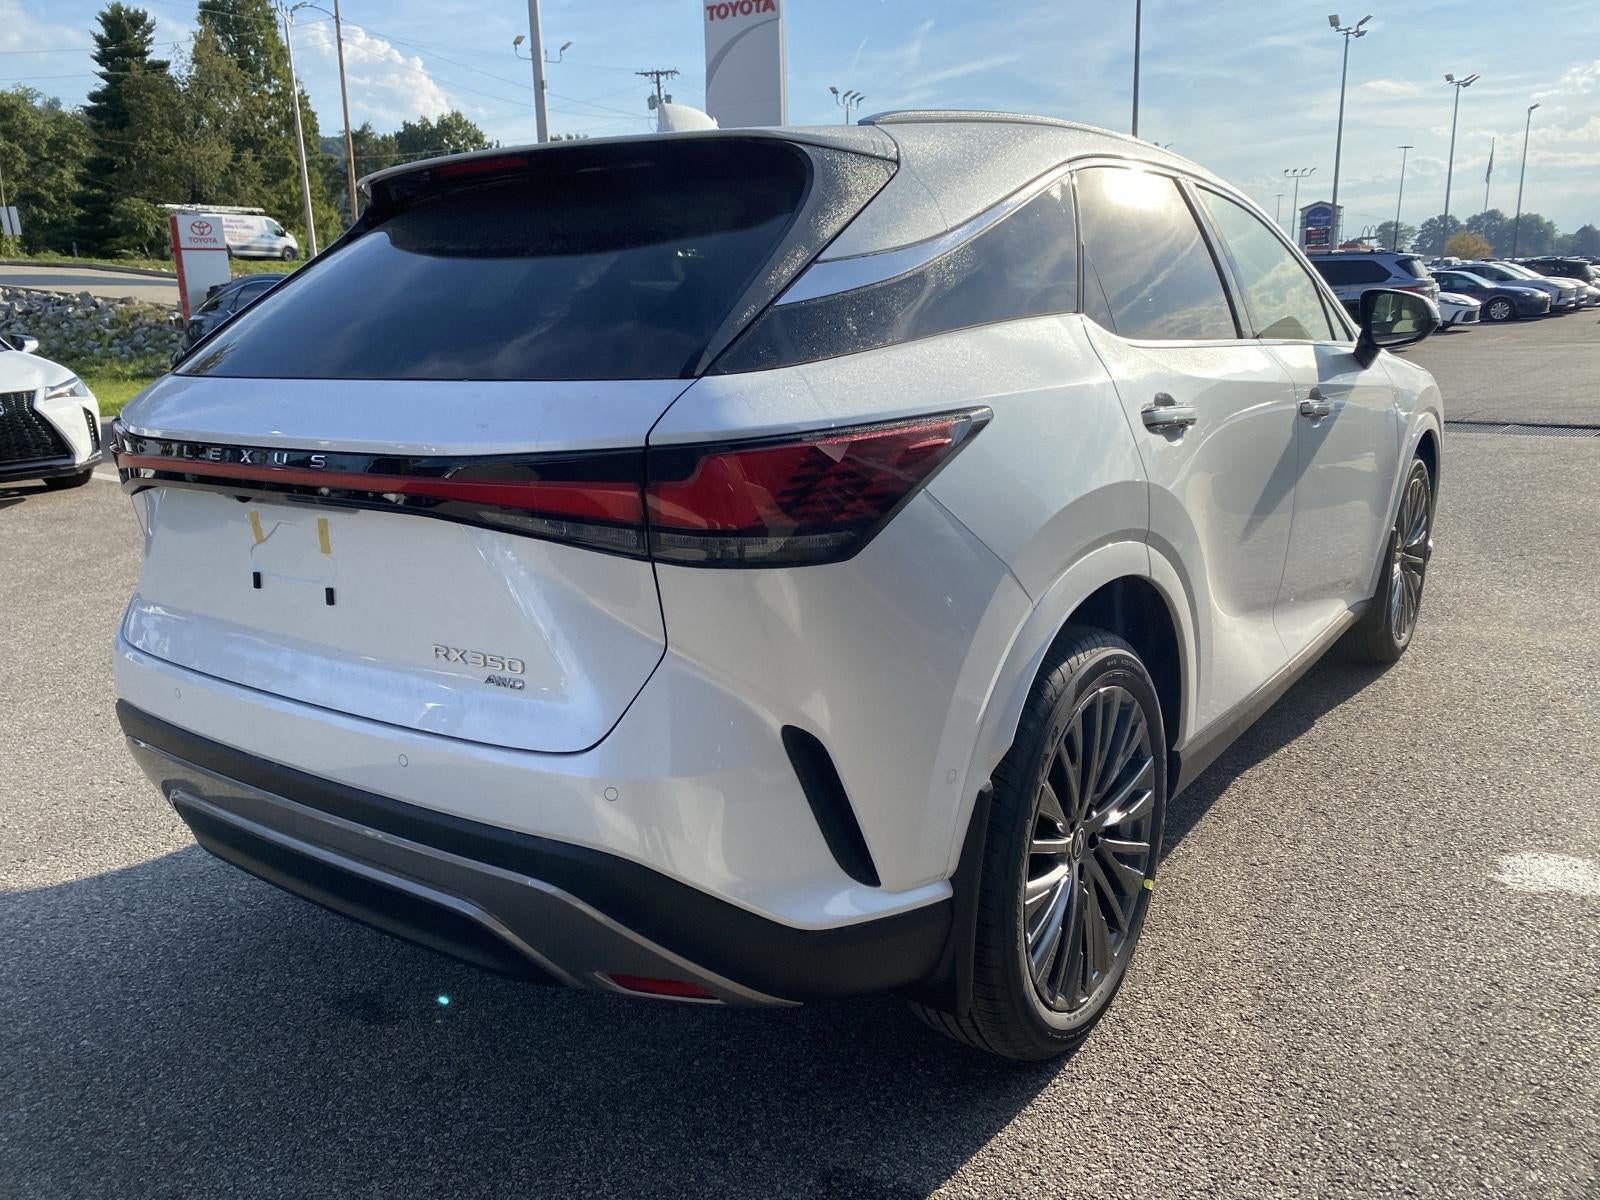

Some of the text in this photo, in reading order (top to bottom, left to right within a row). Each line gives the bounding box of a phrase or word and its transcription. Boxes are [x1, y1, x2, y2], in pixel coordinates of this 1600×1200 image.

[706, 0, 776, 21] TOYOTA
[183, 444, 327, 469] LEXUS
[432, 643, 525, 675] RX350
[484, 674, 525, 690] AWD
